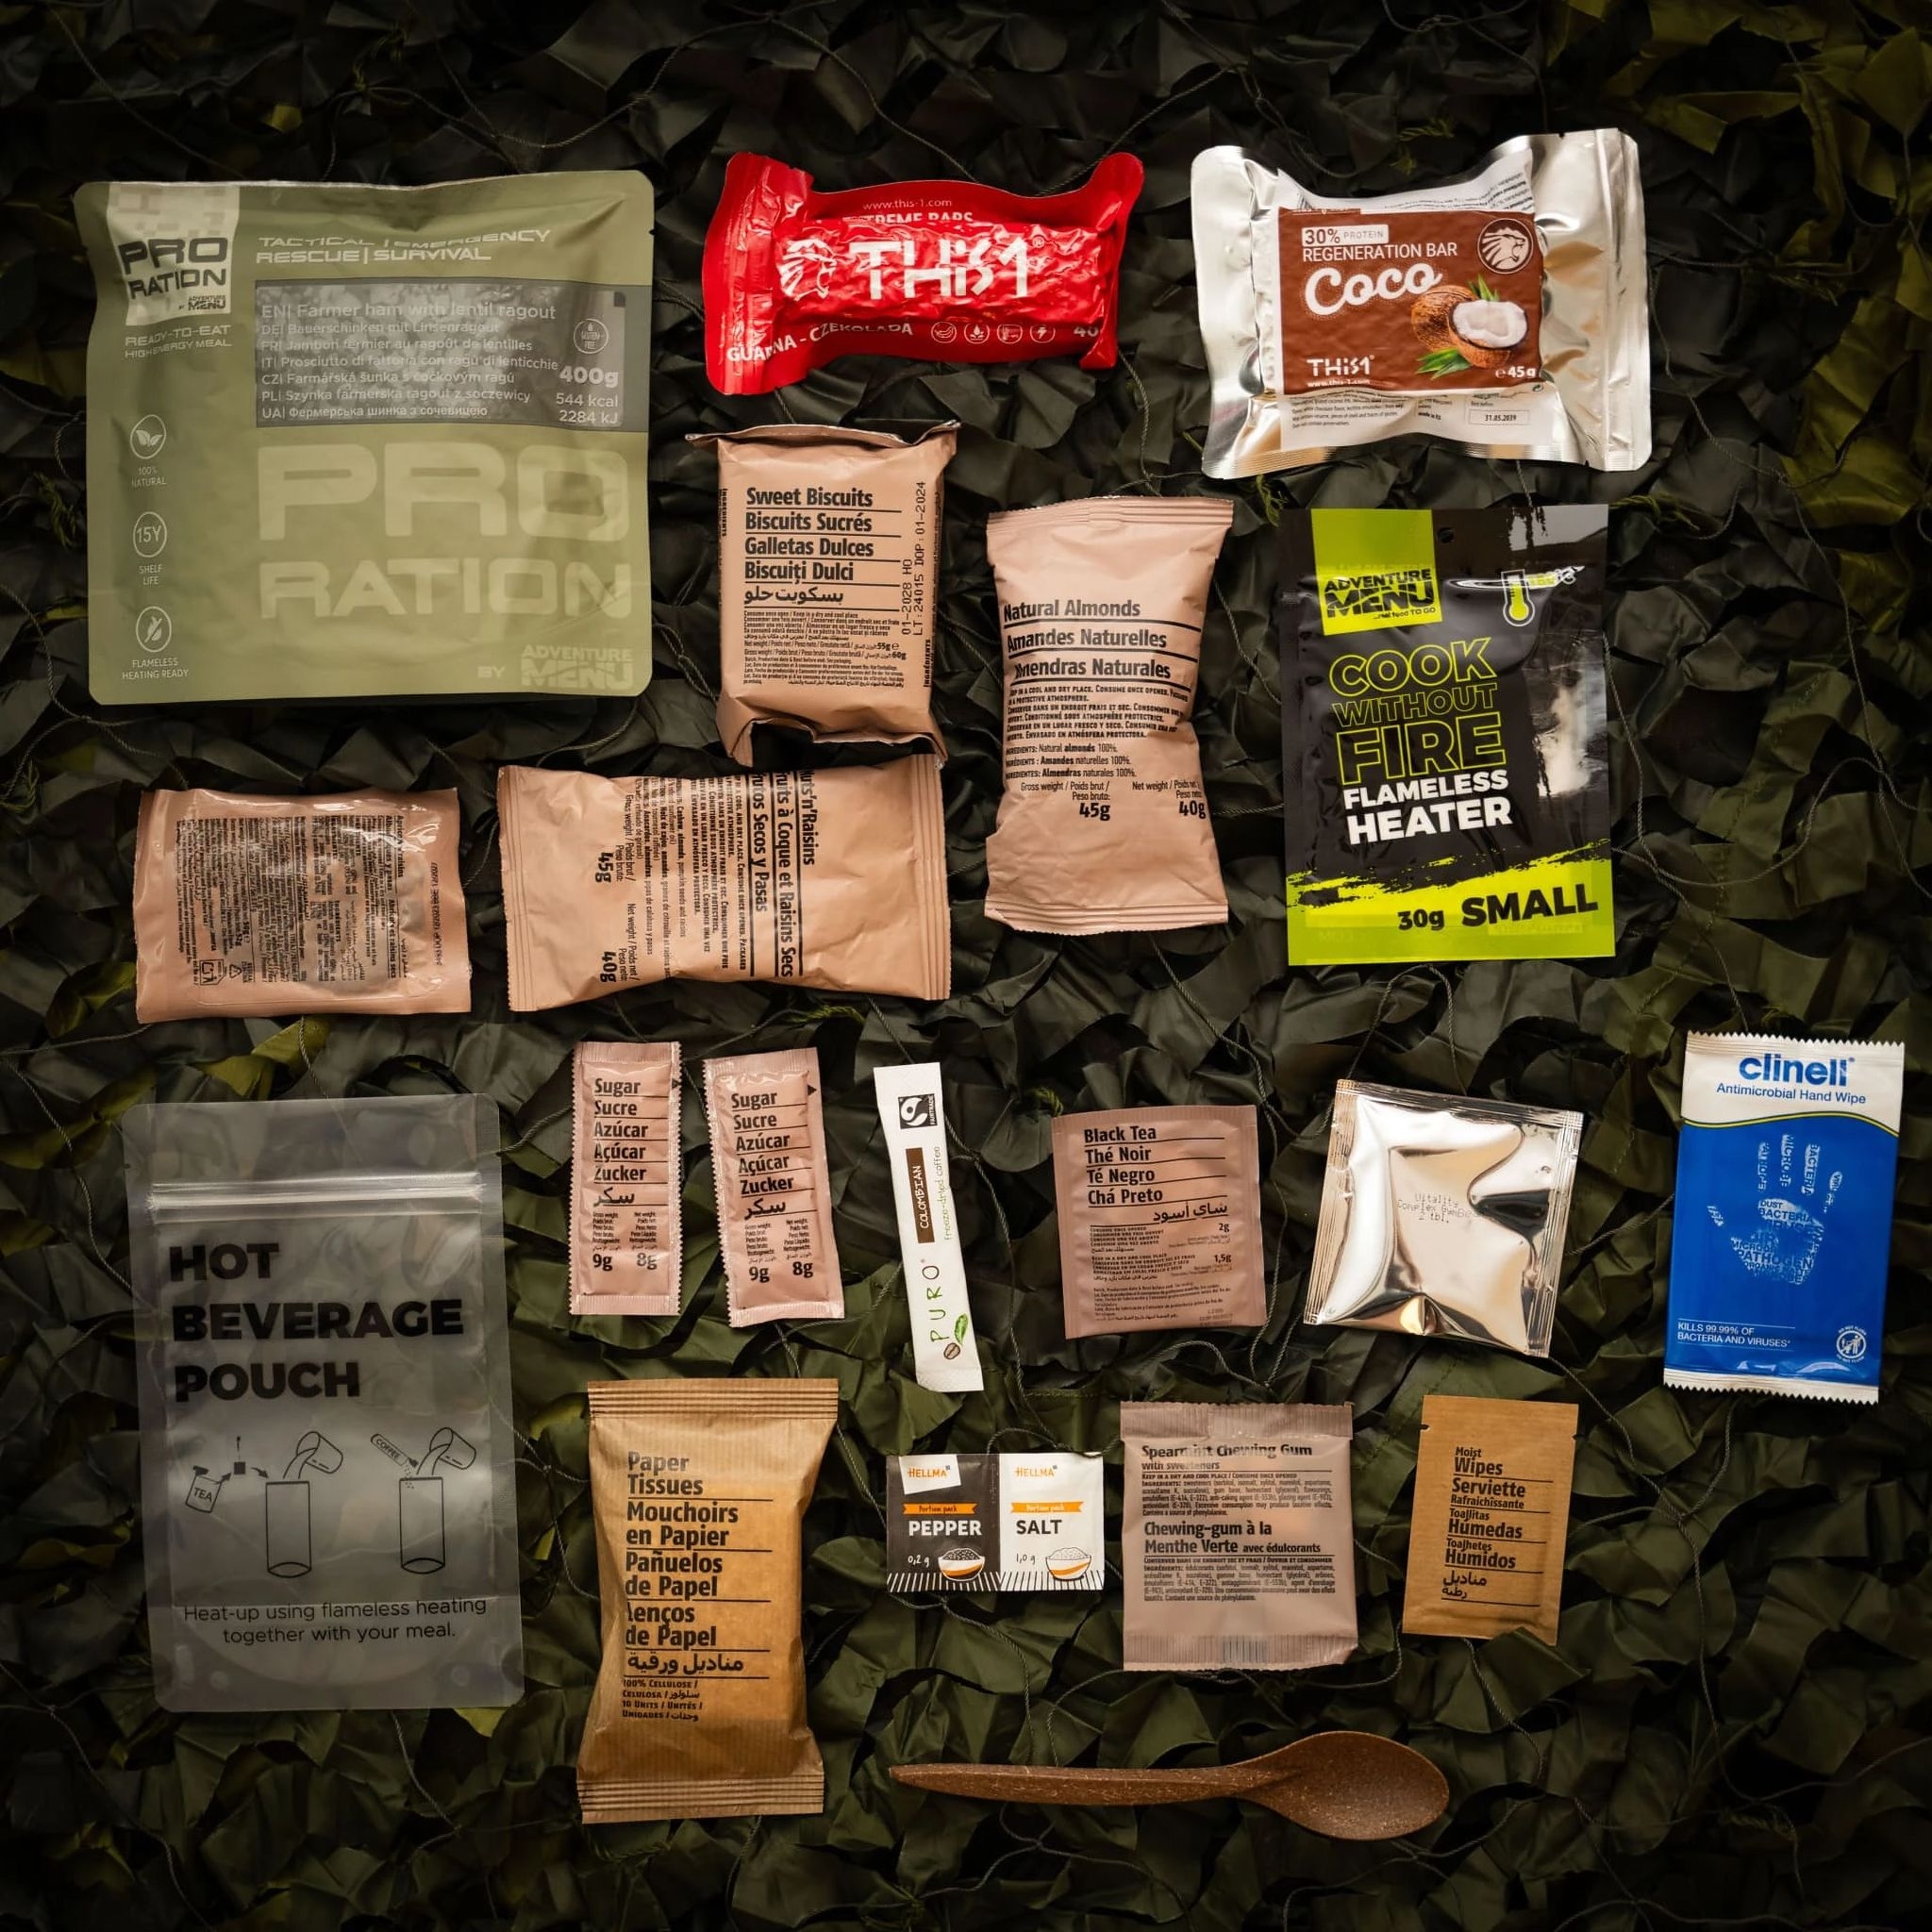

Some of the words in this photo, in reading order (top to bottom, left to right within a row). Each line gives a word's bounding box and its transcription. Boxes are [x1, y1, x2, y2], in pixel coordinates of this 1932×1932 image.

[862, 198, 953, 210] www.this-1.com
[258, 236, 375, 247] TACTICAL
[1305, 228, 1341, 245] 30%
[1342, 229, 1385, 242] PROTEIN
[118, 238, 228, 275] PRO
[373, 247, 492, 262] SURVIVAL
[1302, 243, 1423, 262] REGENERATION
[1425, 242, 1458, 258] BAR
[128, 268, 226, 300] RATION
[1304, 262, 1444, 316] Coco
[297, 304, 360, 318] Farmer
[365, 303, 403, 317] ham
[408, 303, 448, 316] with
[451, 302, 494, 316] lentil
[498, 305, 558, 321] ragout
[125, 325, 232, 347] READY-TO-EAT
[483, 339, 533, 351] lentilles
[558, 366, 620, 389] 400g
[285, 390, 332, 403] Szynka
[466, 390, 531, 405] soczewicy
[556, 392, 584, 407] 544
[587, 394, 619, 408] kcal
[367, 406, 408, 416] шинка
[558, 410, 596, 424] 2284
[131, 477, 167, 488] NATURAL
[258, 441, 631, 543] PRO
[746, 487, 802, 507] Sweet
[807, 487, 874, 508] Biscuits
[745, 510, 811, 531] Biscuits
[816, 512, 873, 533] Sucrés
[136, 525, 162, 544] 15Y
[744, 536, 814, 556] Galletas
[819, 537, 874, 558] Dulces
[812, 561, 855, 582] Dulci
[1324, 568, 1432, 592] ADVENTURE
[258, 557, 633, 620] RATION
[744, 586, 774, 605] حلو
[1324, 580, 1435, 618] MENU
[901, 582, 913, 636] 01-2028
[1004, 599, 1059, 623] Natural
[1063, 599, 1141, 617] Almonds
[1008, 628, 1075, 653] Amandes
[1080, 628, 1168, 648] Naturelles
[132, 658, 179, 668] FLAMELESS
[521, 644, 633, 662] ADVENTURE
[122, 670, 159, 680] HEATING
[161, 668, 190, 678] READY
[521, 658, 635, 691] MENU
[1091, 658, 1172, 679] Naturales
[1329, 636, 1498, 698] COOK
[1331, 682, 1498, 727] WITHOUT
[1336, 711, 1507, 787] FIRE
[1342, 769, 1509, 810] FLAMELESS
[776, 808, 789, 817] à
[1078, 802, 1111, 822] 45g
[1178, 801, 1207, 820] 40g
[1346, 795, 1513, 846] HEATER
[753, 813, 769, 855] Secos
[776, 822, 794, 869] Coque
[595, 851, 614, 883] 45g
[749, 858, 765, 868] y
[779, 872, 793, 888] et
[755, 872, 770, 913] Pasas
[778, 891, 794, 943] Raisins
[1397, 908, 1445, 931] 30g
[1460, 883, 1599, 929] SMALL
[600, 951, 619, 983] 40g
[780, 947, 794, 978] Secs
[1739, 1053, 1849, 1087] clinell
[594, 1077, 641, 1097] Sugar
[1716, 1082, 1797, 1101] Antimicrobial
[1799, 1089, 1833, 1103] Hand
[1835, 1091, 1867, 1105] Wipe
[594, 1099, 638, 1116] Sucre
[731, 1091, 778, 1110] Sugar
[594, 1120, 648, 1138] Azúcar
[733, 1112, 778, 1131] Sucre
[736, 1134, 791, 1153] Azúcar
[1084, 1126, 1125, 1143] Black
[1129, 1125, 1157, 1141] Tea
[593, 1142, 646, 1163] Açúcar
[932, 1145, 942, 1177] coffee
[1085, 1146, 1114, 1164] Thé
[1119, 1145, 1152, 1162] Noir
[593, 1165, 647, 1181] Zucker
[739, 1155, 791, 1176] Açúcar
[740, 1176, 794, 1196] Zucker
[1087, 1167, 1104, 1184] Té
[1108, 1169, 1156, 1186] Negro
[911, 1164, 929, 1229] COLOMBIAN
[1088, 1188, 1115, 1205] Chá
[1121, 1189, 1163, 1204] Preto
[169, 1241, 280, 1283] HOT
[592, 1253, 613, 1272] 9g
[748, 1266, 771, 1284] 9g
[792, 1261, 814, 1279] 8g
[922, 1265, 950, 1344] PURO
[172, 1299, 465, 1342] BEVERAGE
[1677, 1322, 1704, 1333] KILLS
[1705, 1324, 1740, 1335] 99.99%
[1677, 1332, 1724, 1343] BACTERIA
[1724, 1335, 1746, 1344] AND
[175, 1361, 361, 1403] POUCH
[375, 1437, 401, 1460] COFFEE
[1280, 1443, 1313, 1456] Gum
[1455, 1446, 1482, 1458] Moist
[627, 1451, 690, 1476] Paper
[907, 1467, 948, 1478] HELLMA
[1014, 1467, 1055, 1477] HELLMA
[1454, 1457, 1504, 1477] Wipes
[192, 1486, 213, 1503] TEA
[627, 1474, 704, 1496] Tissues
[1452, 1477, 1526, 1498] Serviette
[627, 1500, 739, 1524] Mouchoirs
[625, 1528, 652, 1545] en
[660, 1524, 729, 1549] Papier
[908, 1520, 983, 1537] PEPPER
[1016, 1519, 1063, 1535] SALT
[1143, 1521, 1242, 1539] Chewing-gum
[1246, 1520, 1256, 1535] à
[1259, 1522, 1273, 1536] la
[1448, 1517, 1524, 1539] Húmedas
[1144, 1540, 1197, 1553] Menthe
[1201, 1540, 1239, 1553] Verte
[1266, 1542, 1321, 1553] édulcorants
[1446, 1538, 1492, 1552] Toalhetes
[625, 1550, 723, 1574] Pañuelos
[1444, 1547, 1517, 1569] Húmidos
[625, 1575, 651, 1596] de
[658, 1575, 719, 1601] Papel
[183, 1605, 260, 1624] Heat-up
[265, 1605, 316, 1623] using
[321, 1600, 410, 1619] flameless
[416, 1597, 488, 1616] heating
[223, 1626, 306, 1646] together
[310, 1624, 351, 1641] with
[357, 1629, 400, 1645] your
[405, 1622, 457, 1640] meal.
[625, 1624, 651, 1646] de
[658, 1624, 717, 1651] Papel
